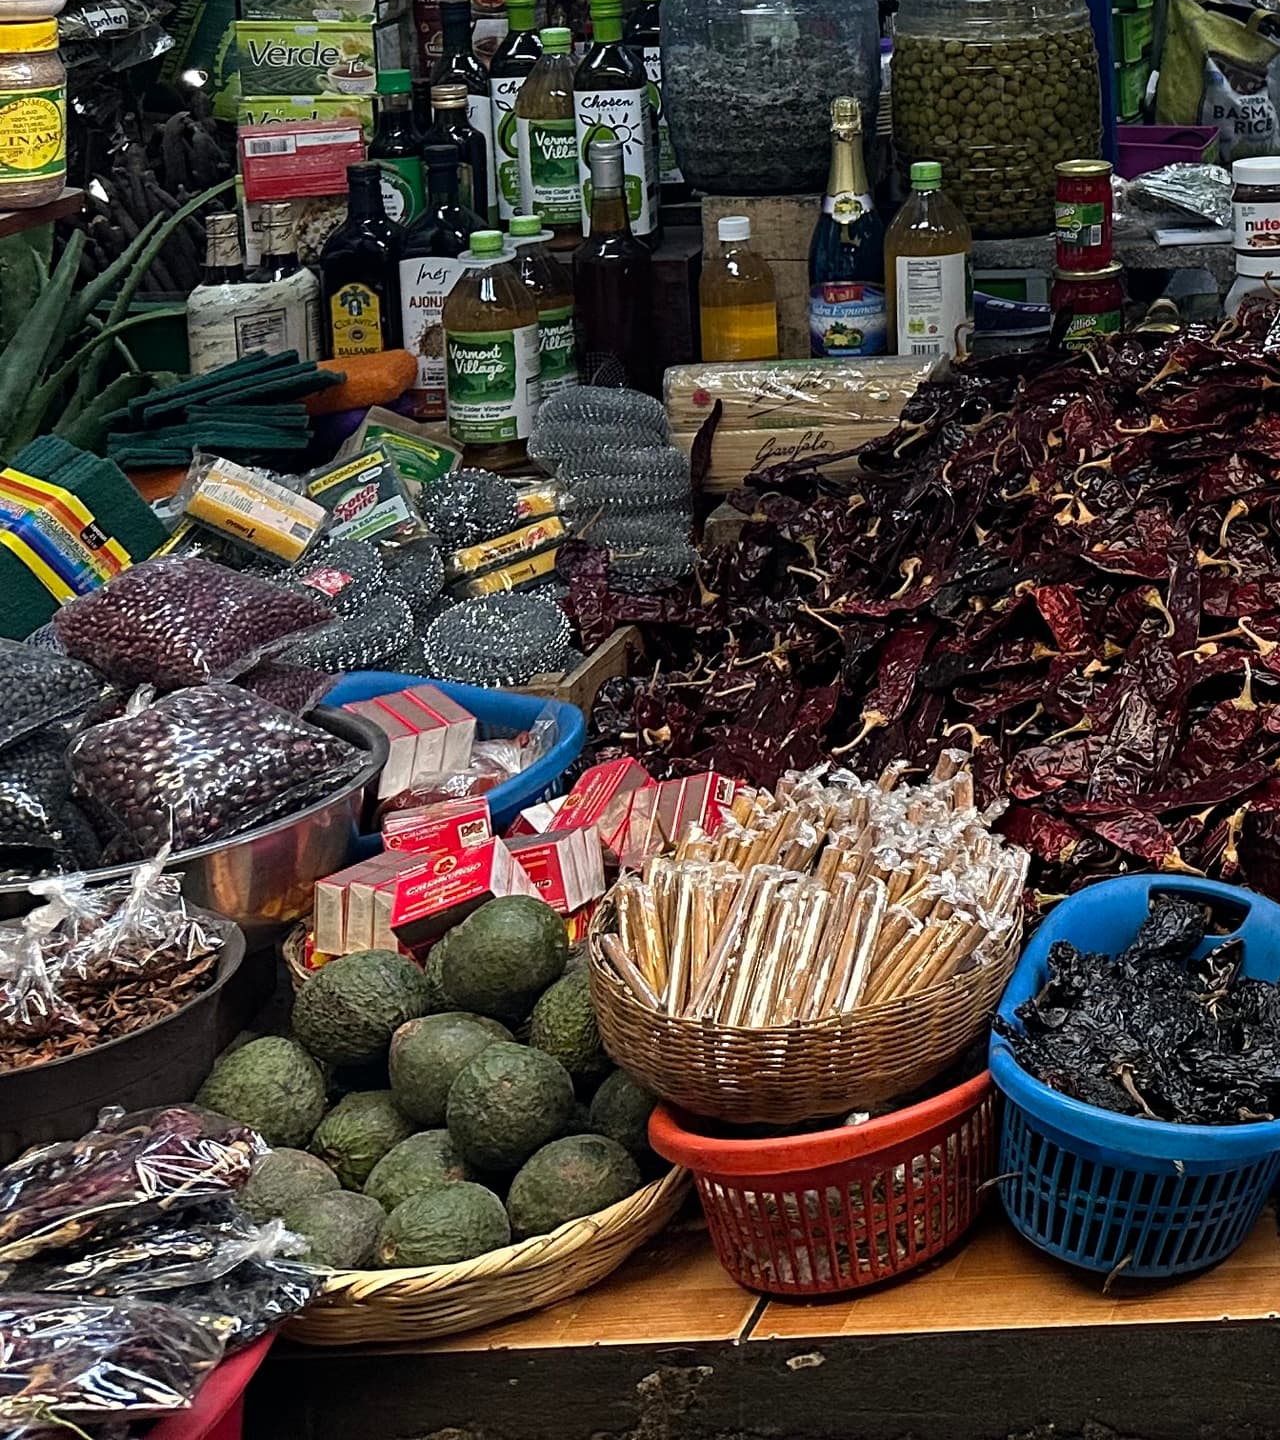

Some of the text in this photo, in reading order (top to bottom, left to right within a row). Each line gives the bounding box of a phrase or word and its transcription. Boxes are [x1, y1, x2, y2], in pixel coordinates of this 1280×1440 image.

[249, 40, 340, 67] Verde
[580, 95, 634, 110] Chosen
[1234, 118, 1273, 135] RICE
[535, 131, 577, 147] Vermo
[542, 145, 579, 161] Villa
[416, 263, 450, 286] Inés
[410, 296, 448, 310] AJONJ
[449, 343, 503, 360] Vermont
[455, 358, 507, 381] Village
[334, 482, 379, 512] Scotch
[343, 494, 378, 522] Brite
